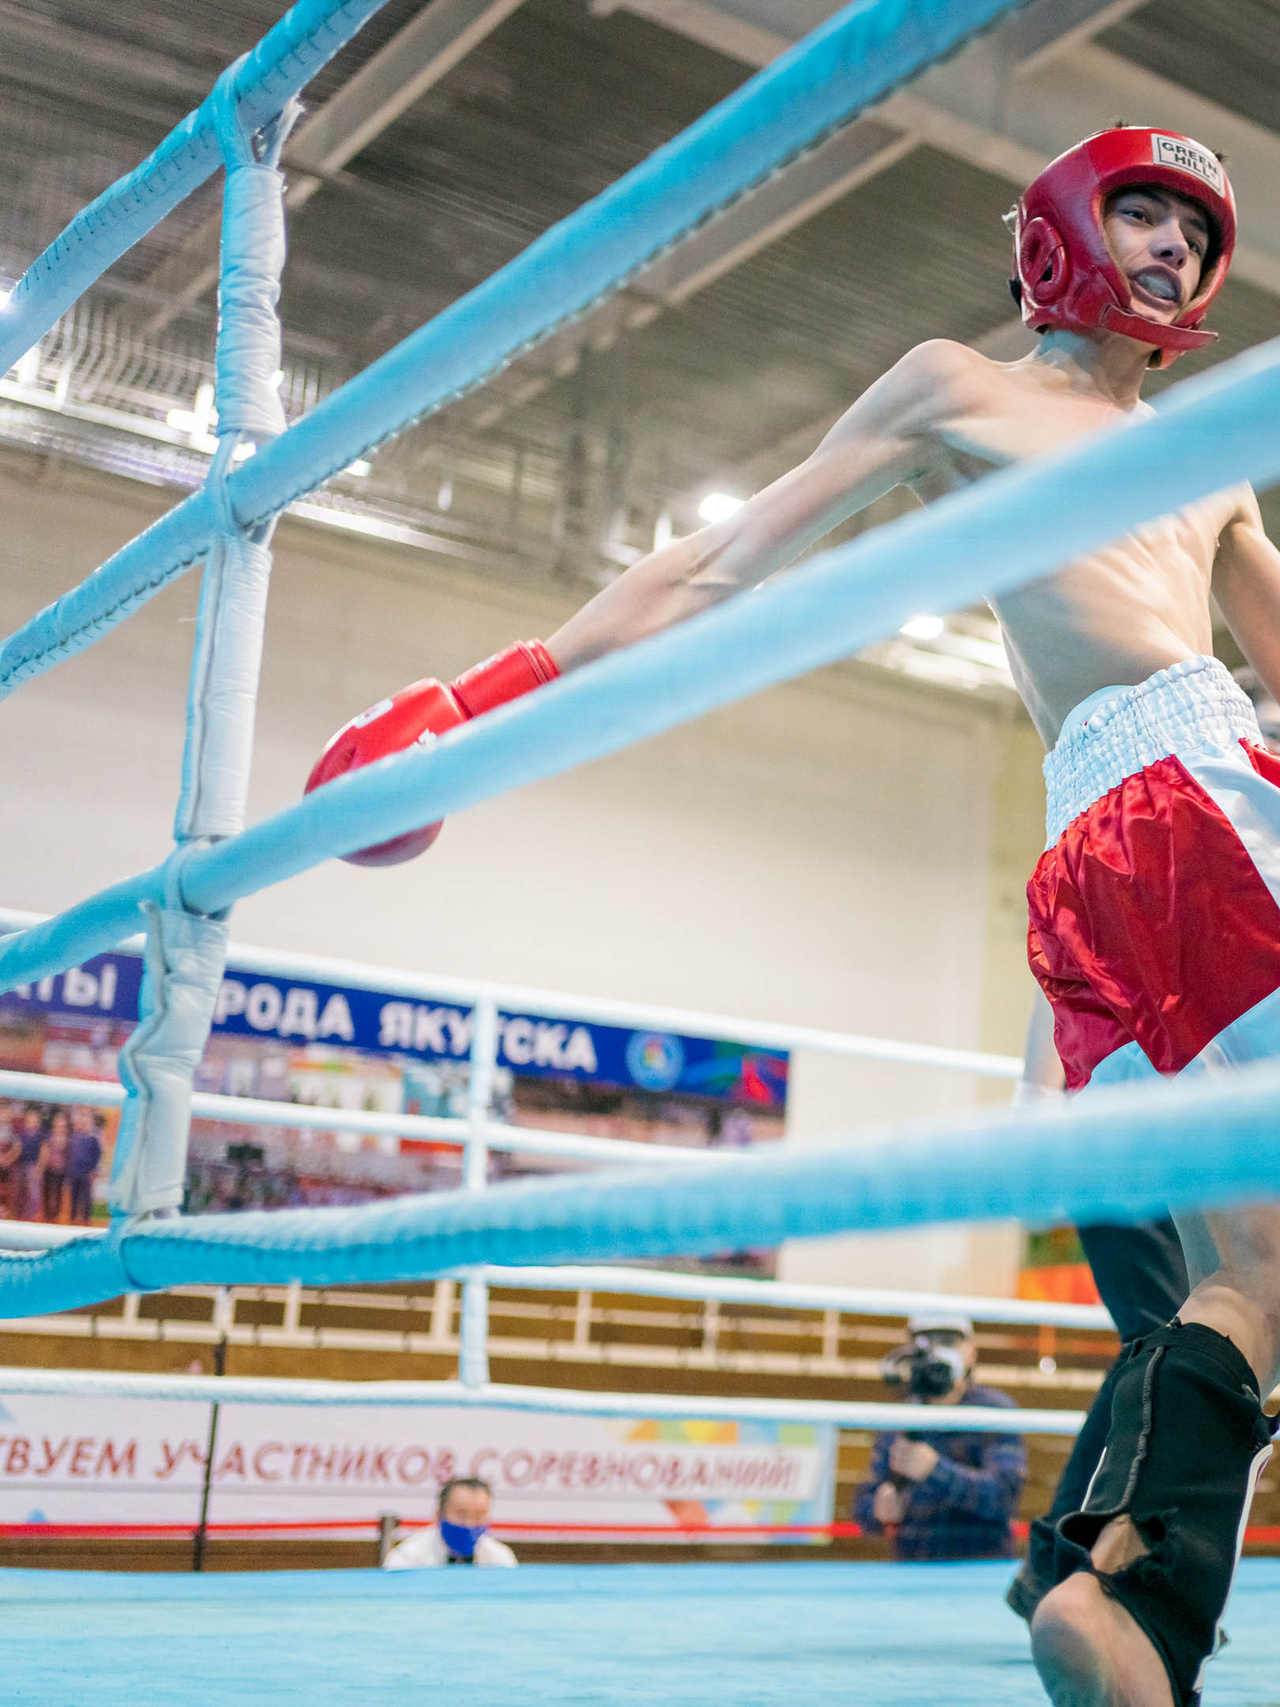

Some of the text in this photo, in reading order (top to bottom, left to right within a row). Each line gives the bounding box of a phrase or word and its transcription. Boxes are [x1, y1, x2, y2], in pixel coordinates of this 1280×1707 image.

[1161, 141, 1218, 175] GREEN
[1174, 153, 1211, 179] HILL
[211, 978, 354, 1042] РОДА
[378, 1000, 599, 1074] ЯКУСКА
[0, 1437, 137, 1478] ВУЕМ
